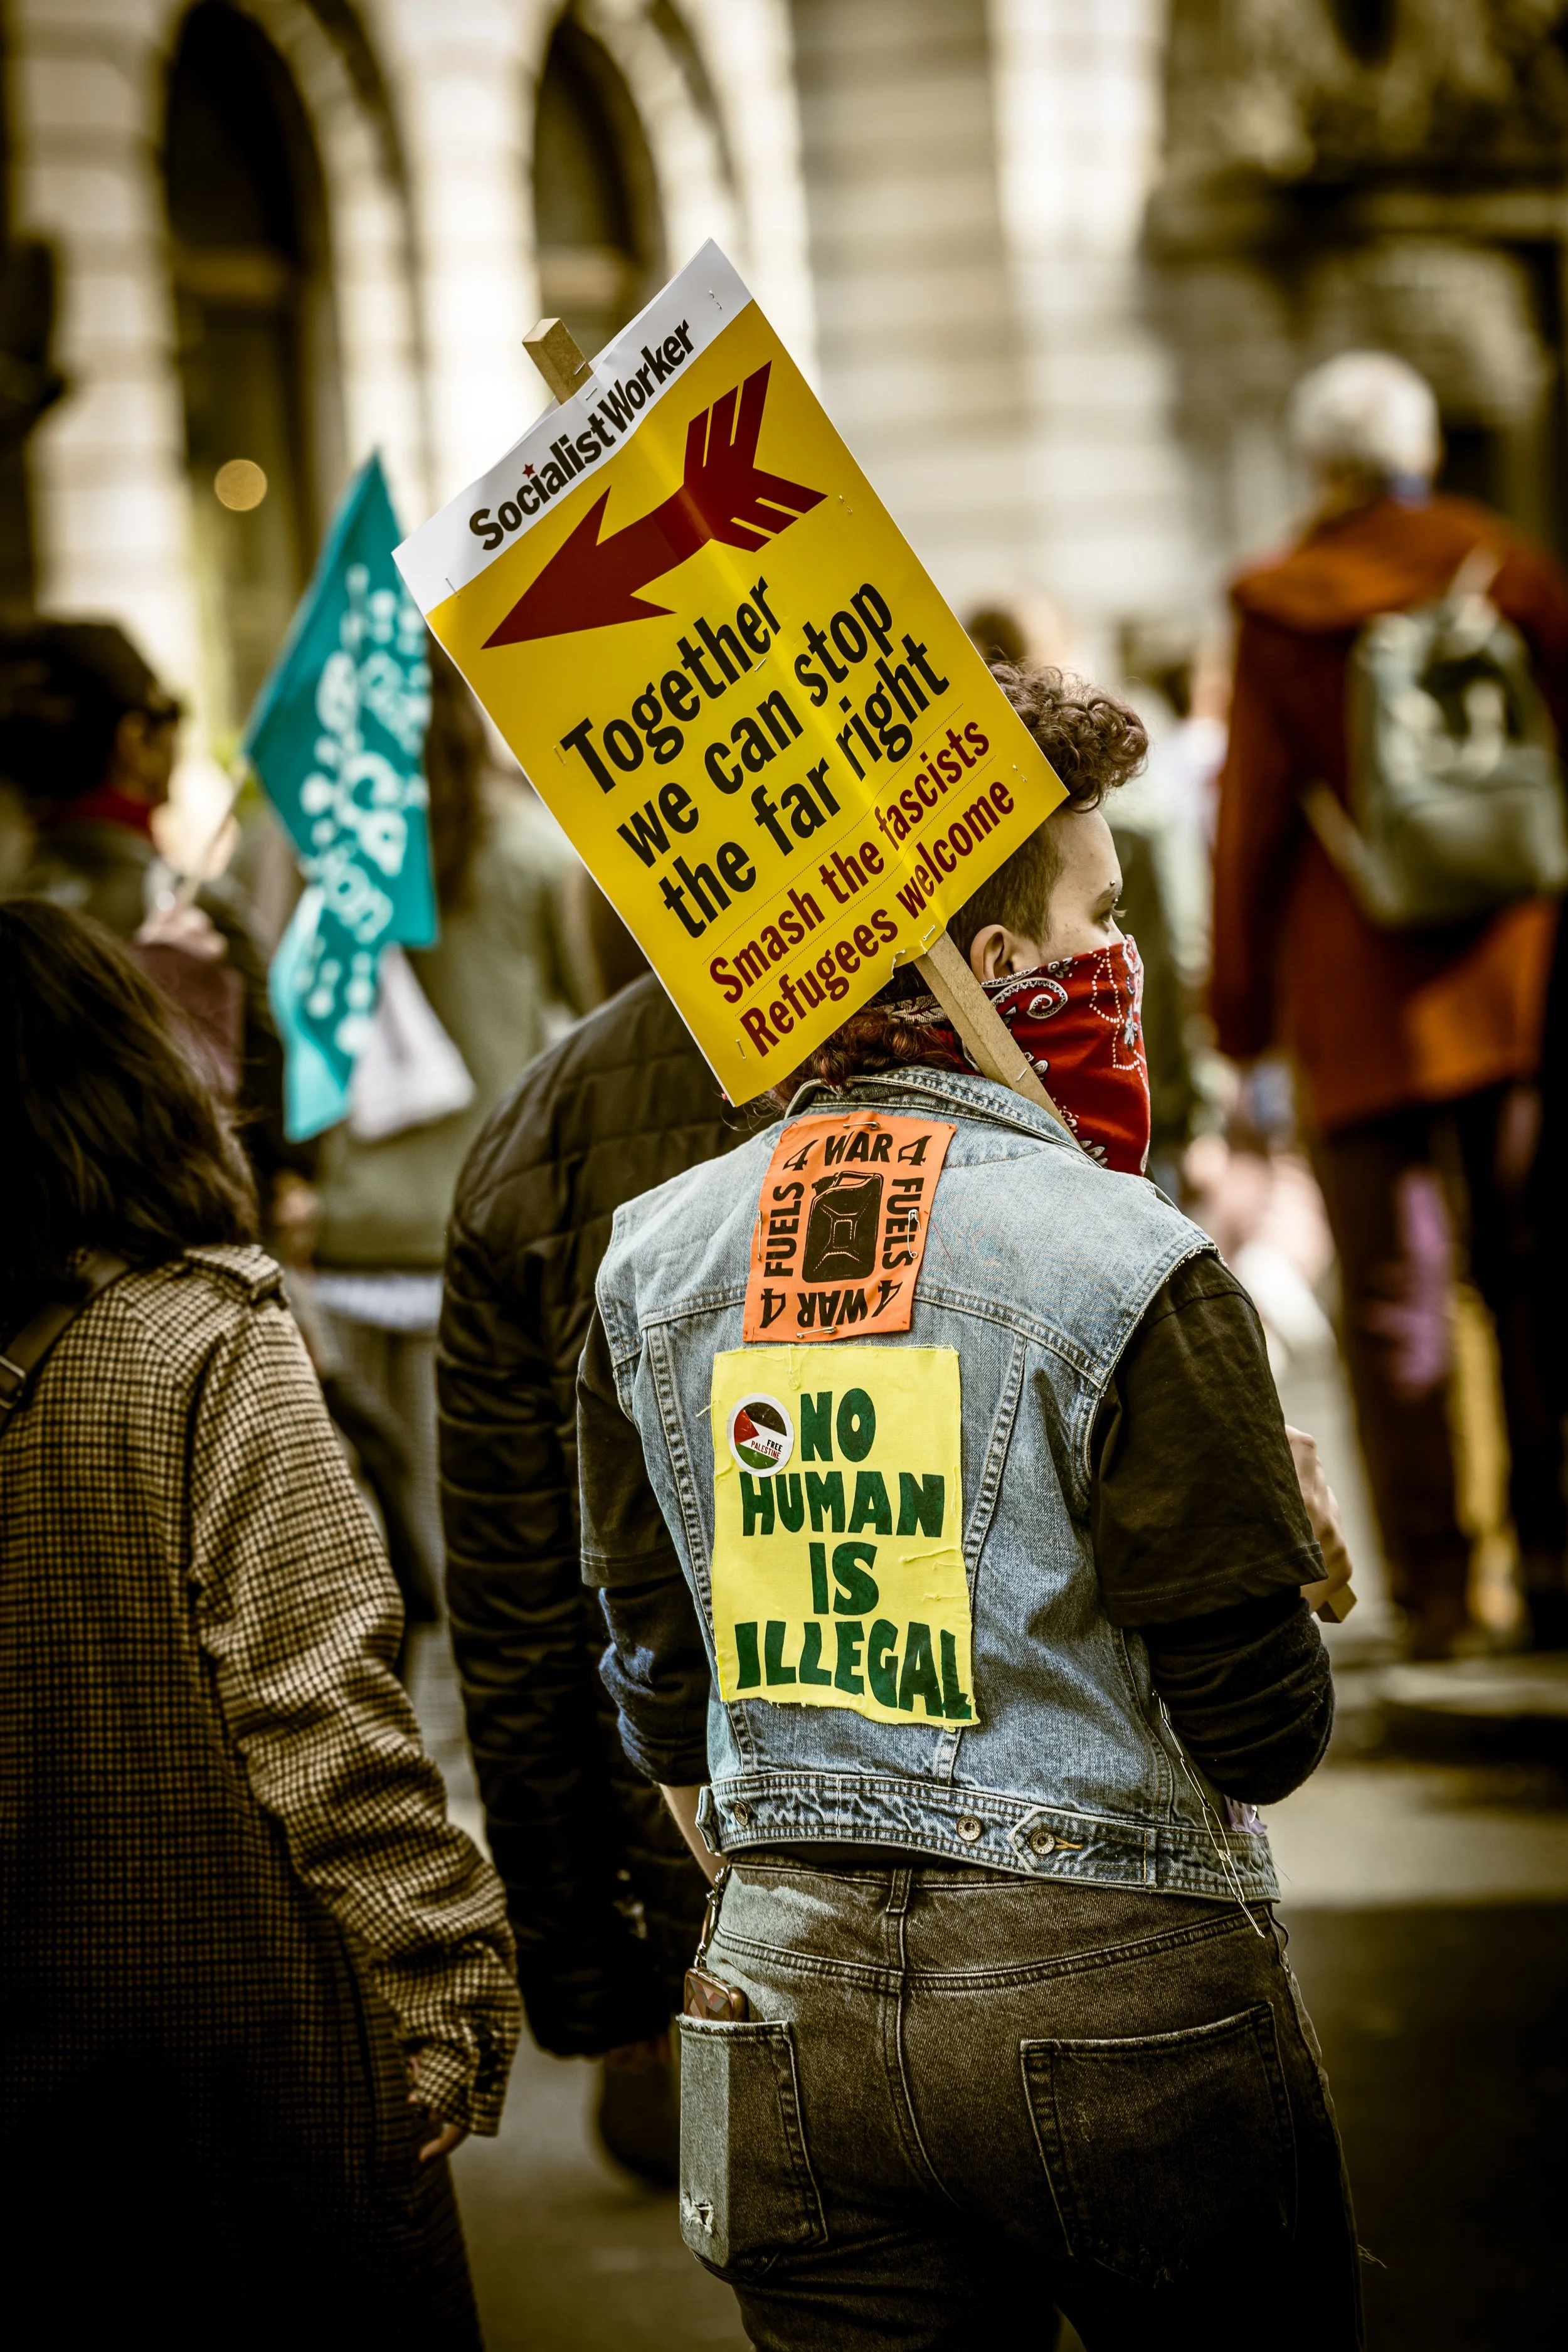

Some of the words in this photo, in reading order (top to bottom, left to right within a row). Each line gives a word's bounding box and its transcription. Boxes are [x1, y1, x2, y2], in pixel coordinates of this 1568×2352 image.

[559, 575, 781, 795] Together
[616, 782, 699, 869] we
[704, 690, 804, 795] can
[793, 583, 893, 707] stop
[658, 841, 757, 939] the
[751, 756, 841, 857] far
[835, 633, 950, 781] right
[709, 887, 826, 1004] Smash
[818, 842, 885, 904] the
[874, 721, 990, 852] fascists
[739, 908, 899, 1058] Refugees
[896, 781, 1015, 919] welcome
[782, 1139, 819, 1172] 4
[824, 1131, 894, 1167] WAR
[898, 1135, 933, 1167] 4
[763, 1182, 805, 1278] FUELS
[881, 1177, 924, 1270] FUELS
[760, 1288, 786, 1329] 4
[797, 1288, 869, 1328] WAR
[871, 1279, 903, 1318] 4
[751, 1440, 781, 1459] PALESTINE
[766, 1439, 783, 1453] FREE
[800, 1387, 876, 1463] NO
[739, 1471, 945, 1537] HUMAN
[809, 1542, 880, 1616] IS
[734, 1618, 973, 1720] ILLEGAL
